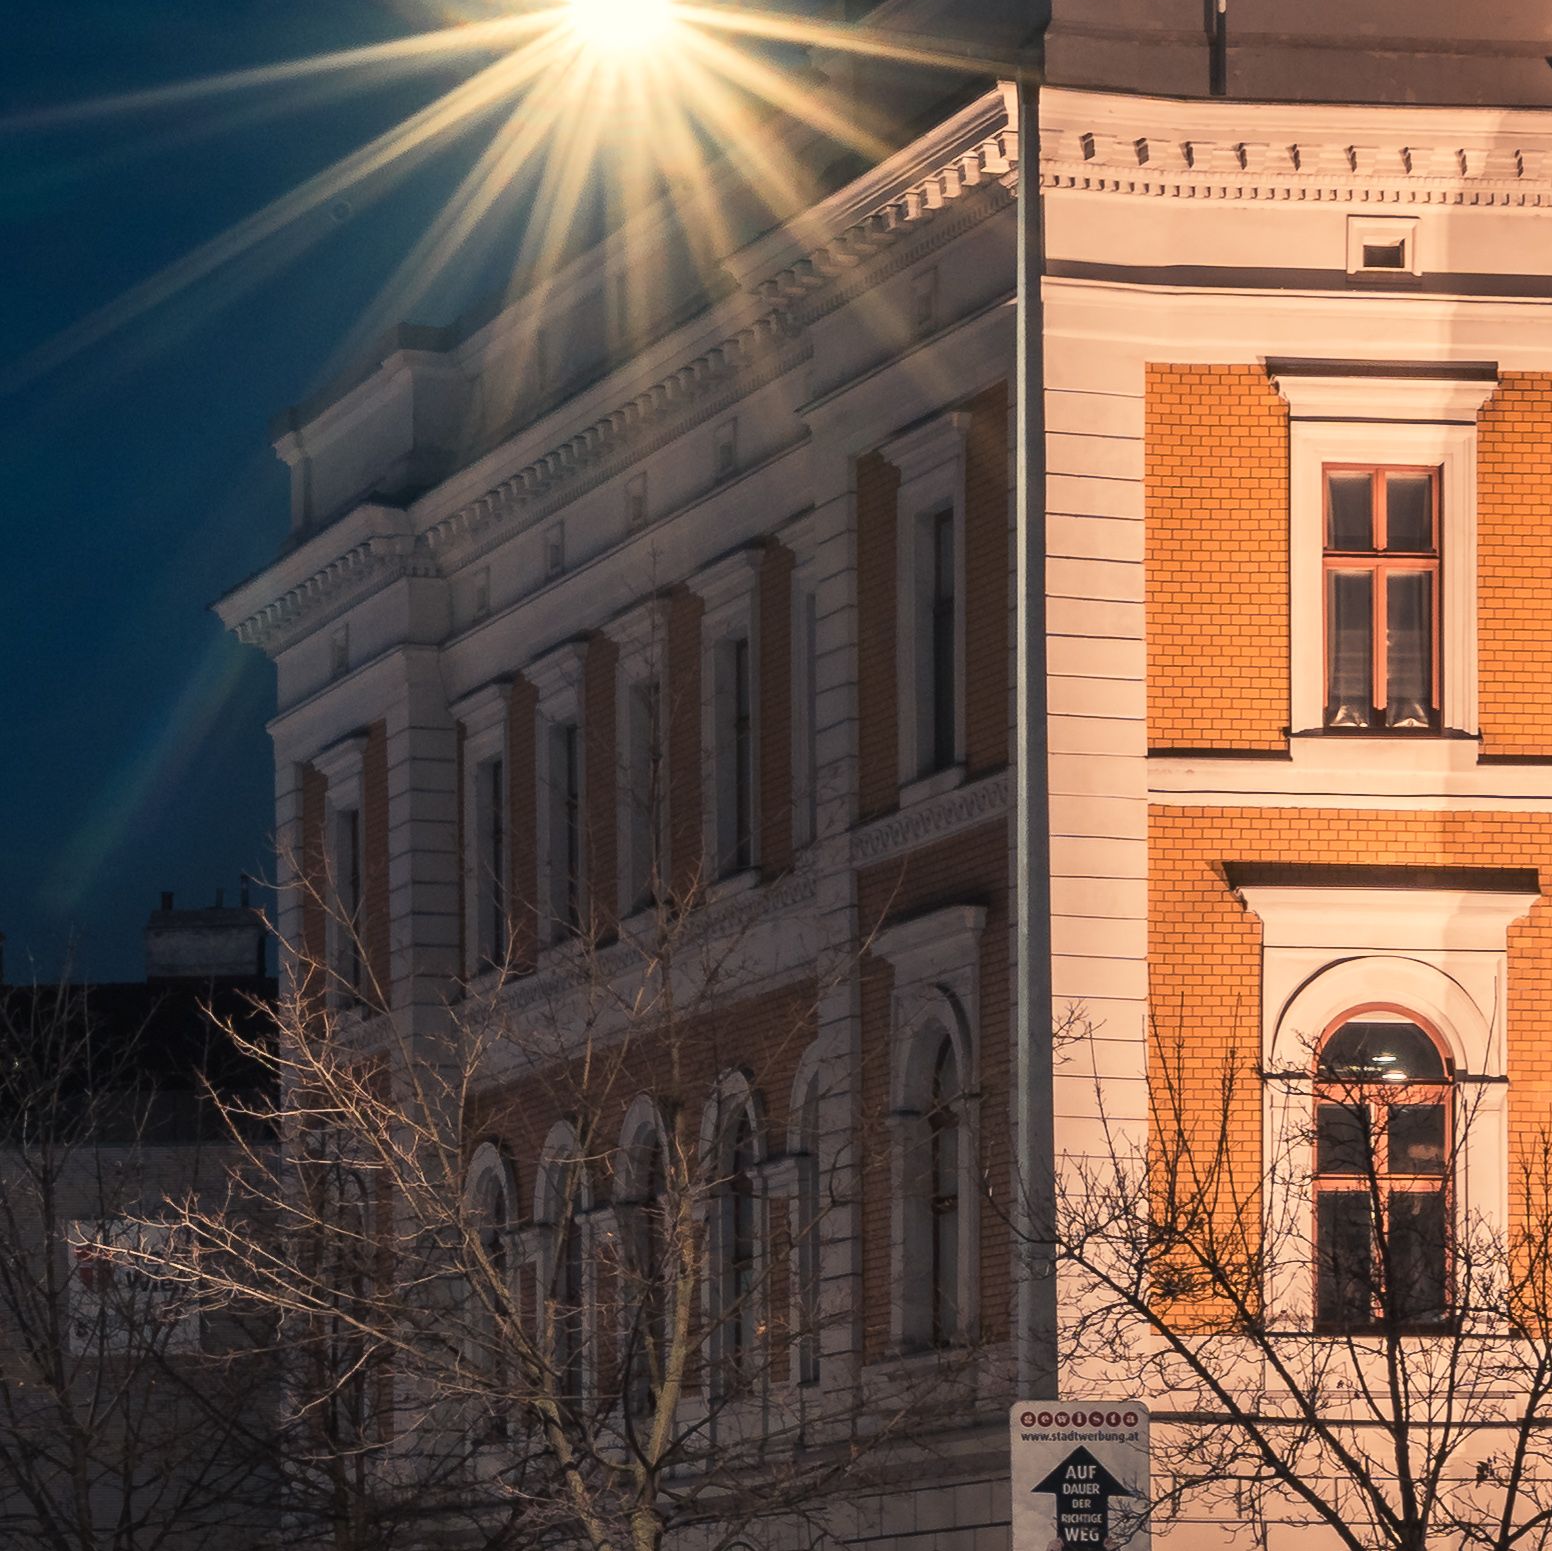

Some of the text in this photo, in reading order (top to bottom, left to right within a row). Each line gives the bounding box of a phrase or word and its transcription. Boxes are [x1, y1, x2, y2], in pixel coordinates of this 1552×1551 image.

[1021, 1411, 1138, 1427] gewista
[1021, 1430, 1139, 1443] www.stadtwerbung.at
[1065, 1465, 1097, 1479] AUF
[1062, 1483, 1100, 1494] DAUER
[1072, 1499, 1091, 1508] DER
[1061, 1513, 1103, 1523] RICHTIGE
[1064, 1527, 1100, 1542] WEG
